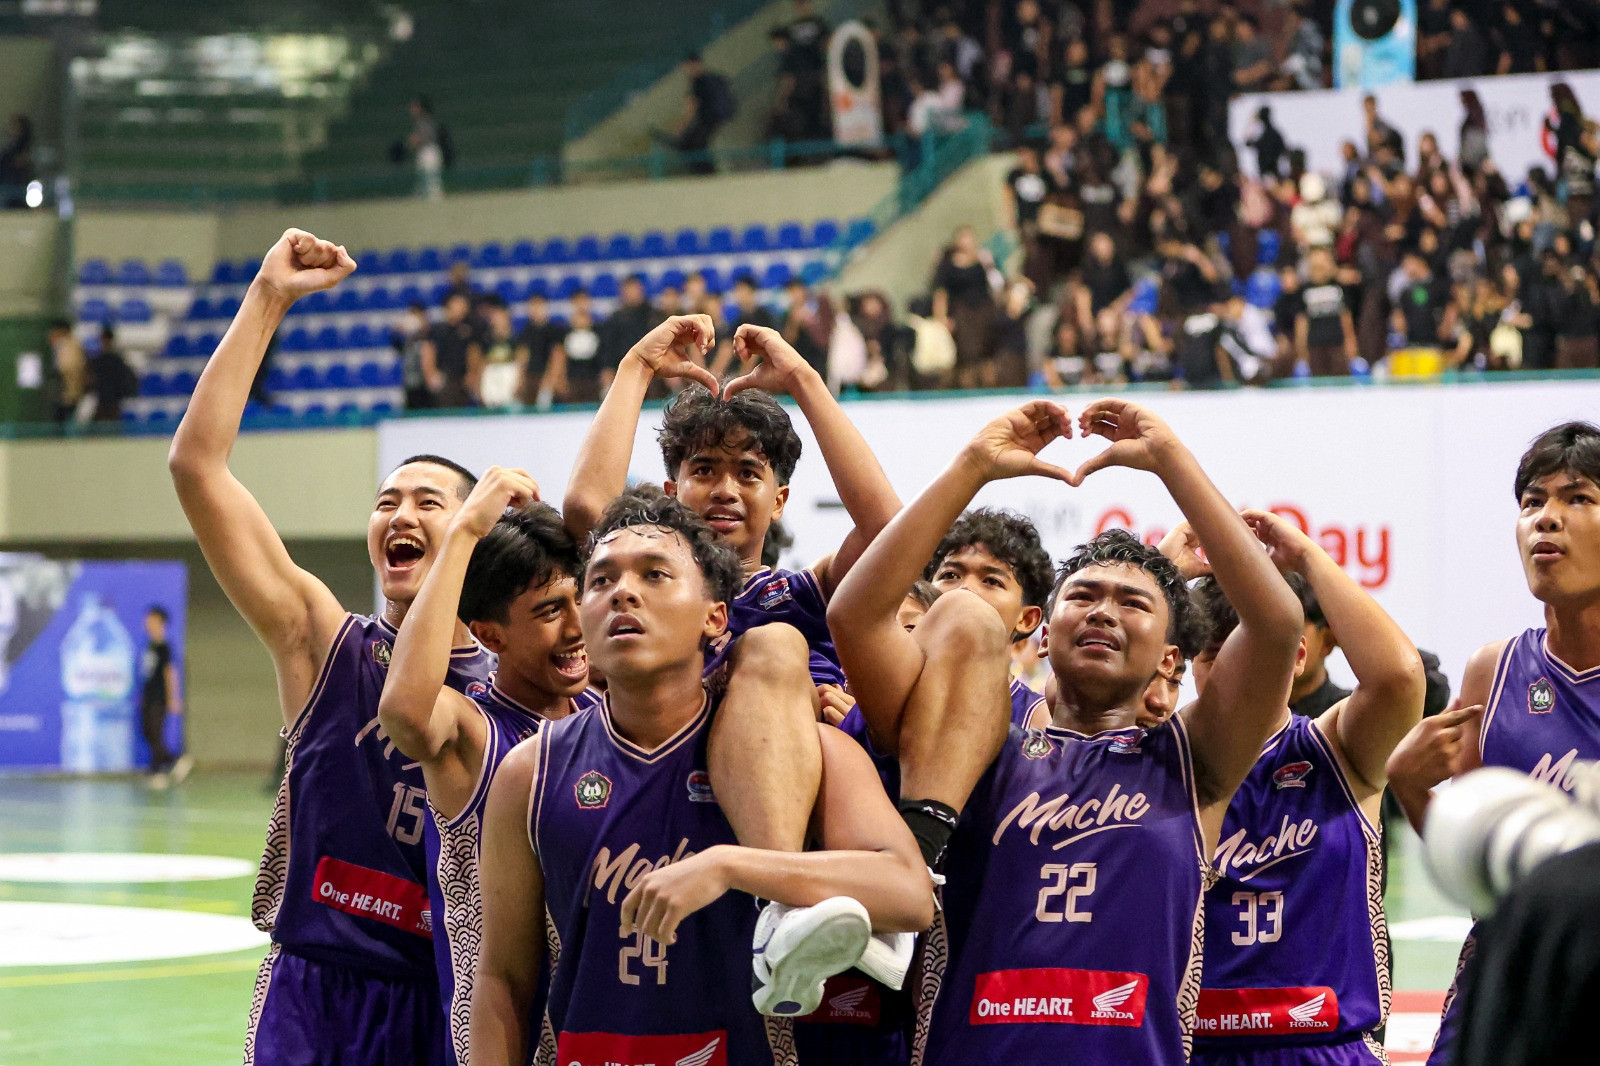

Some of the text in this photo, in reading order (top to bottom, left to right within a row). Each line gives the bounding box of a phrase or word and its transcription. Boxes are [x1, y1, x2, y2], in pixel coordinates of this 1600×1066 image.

[386, 782, 426, 846] 15
[992, 783, 1150, 846] Mache
[319, 881, 403, 921] One HEART.
[1035, 862, 1097, 923] 22
[1231, 890, 1284, 946] 33
[618, 922, 669, 986] 24
[829, 1010, 872, 1019] HONDA
[977, 997, 1073, 1017] One HEART.
[1090, 1010, 1135, 1020] HONDA
[1220, 1012, 1273, 1031] HEART.
[1288, 1020, 1329, 1028] HONDA
